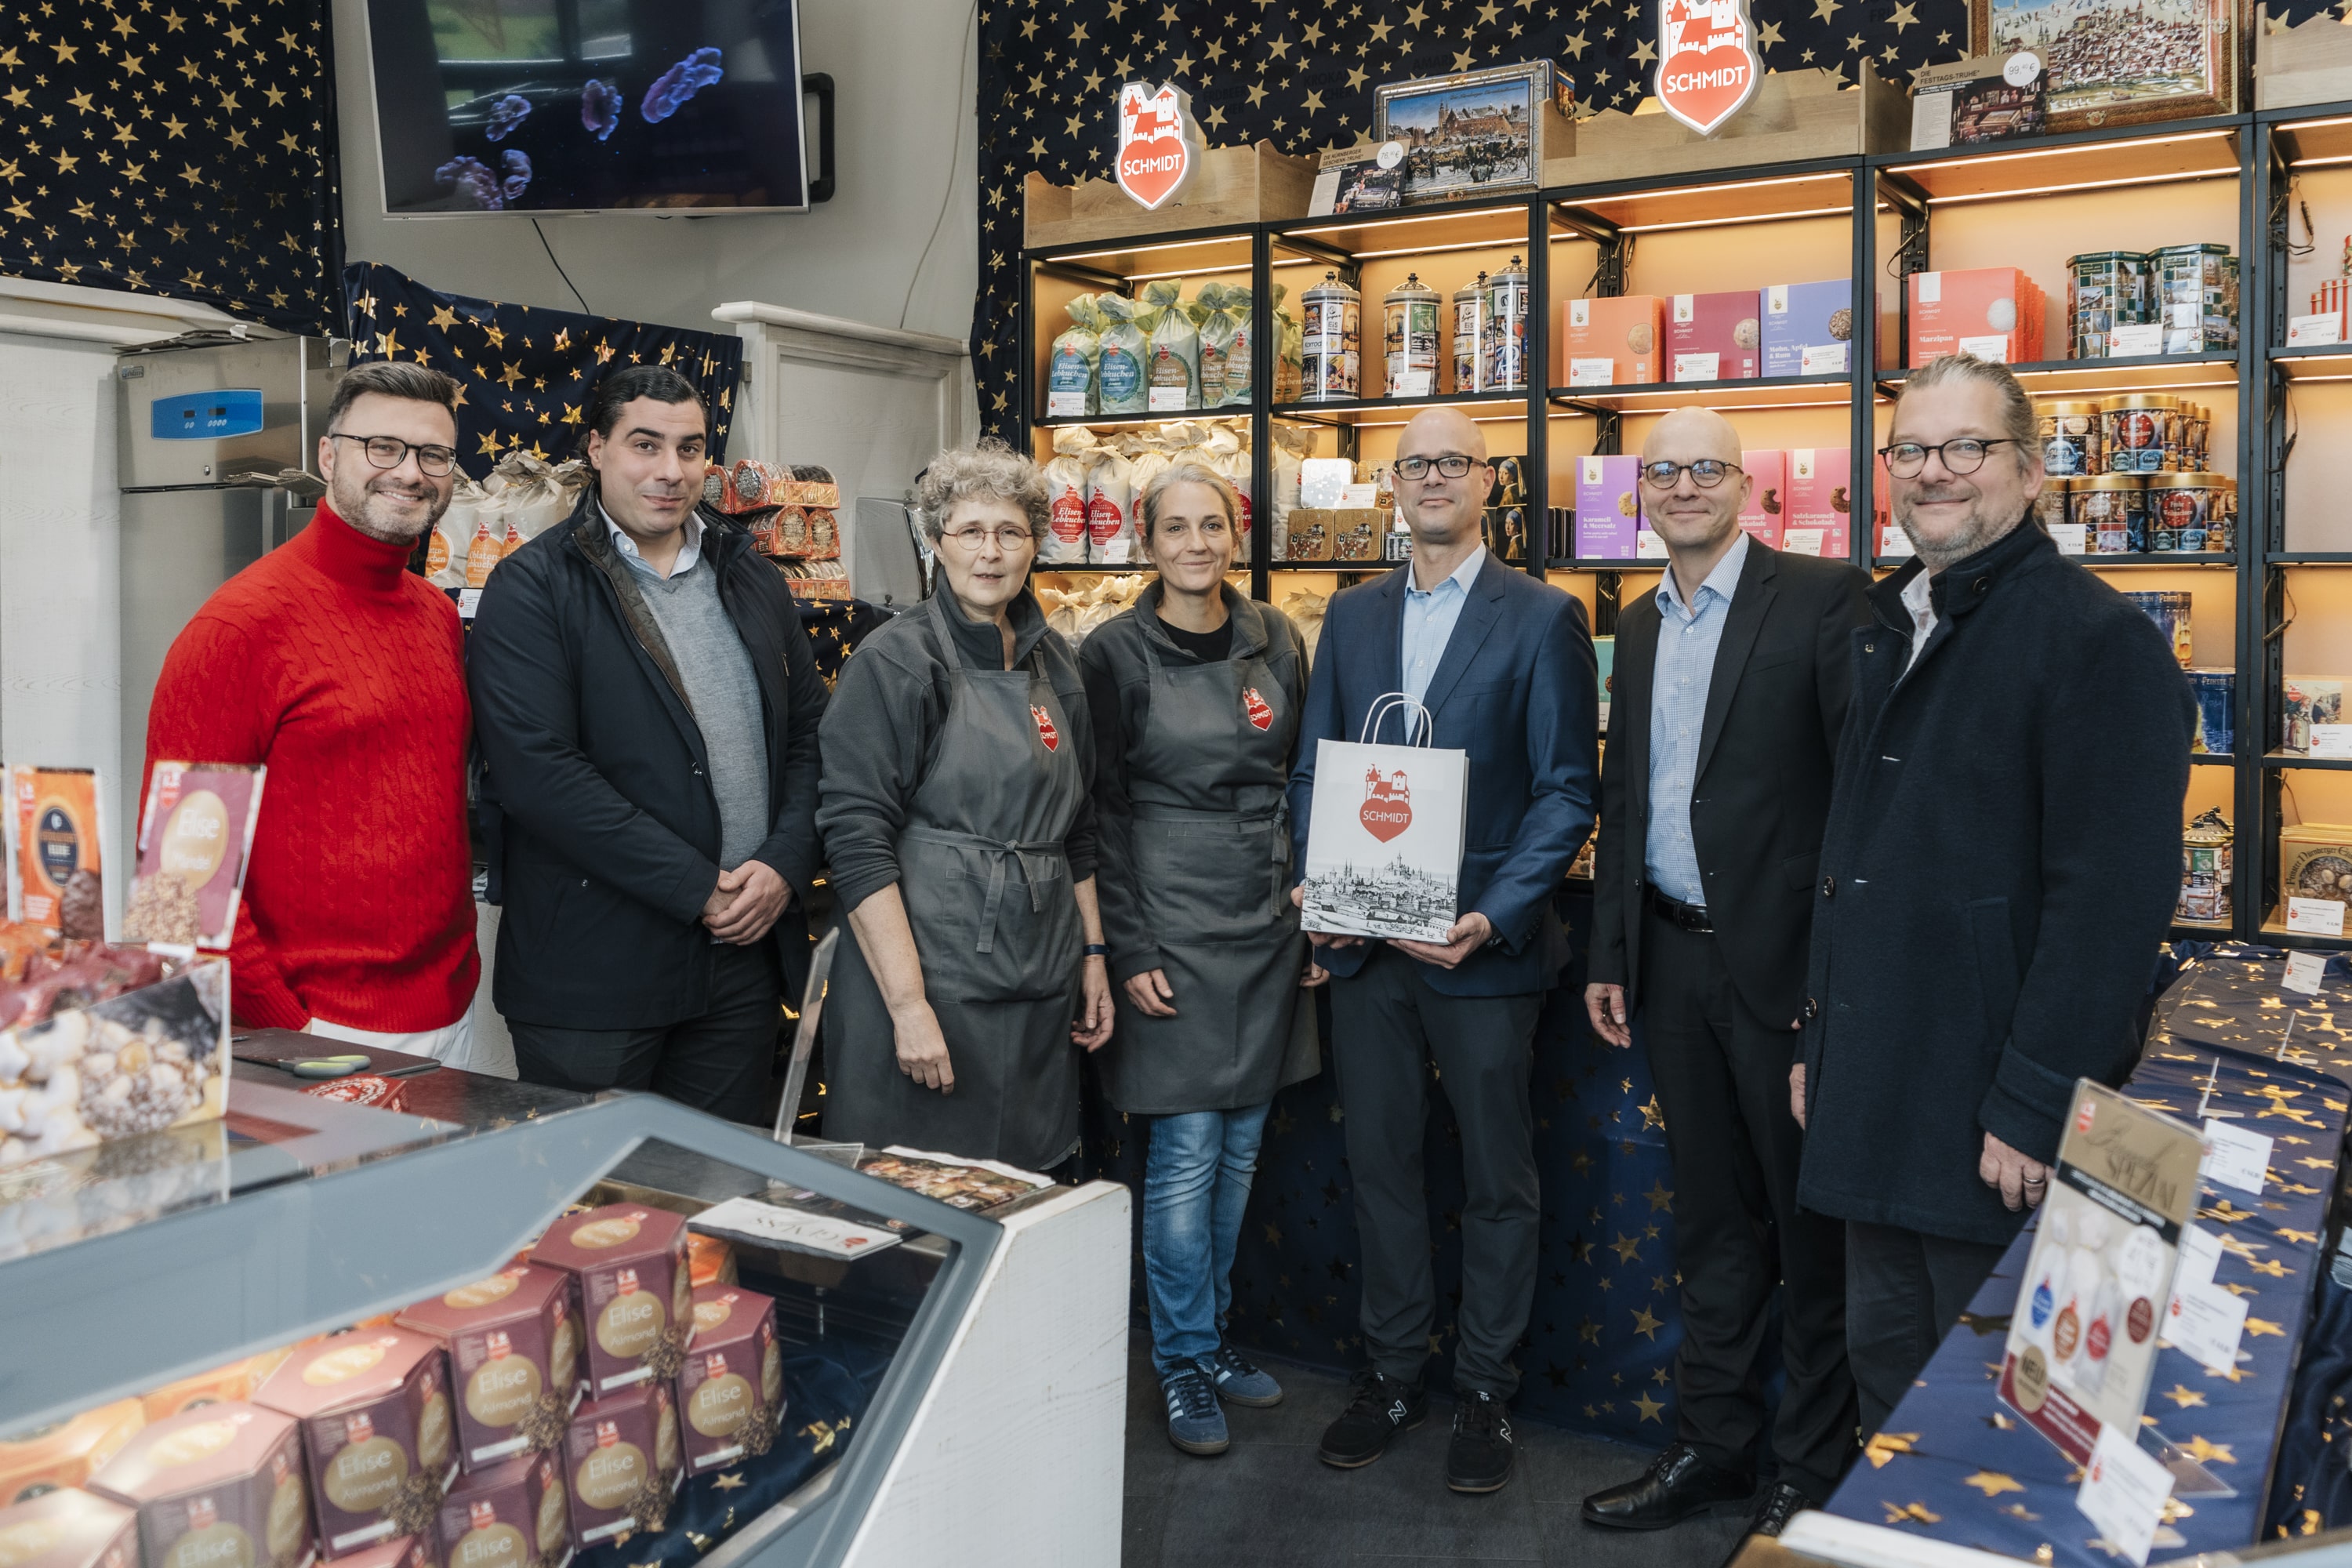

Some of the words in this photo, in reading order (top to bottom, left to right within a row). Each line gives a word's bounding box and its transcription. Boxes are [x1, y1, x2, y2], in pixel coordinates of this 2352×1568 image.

[1666, 65, 1746, 94] SCHMIDT
[1123, 154, 1181, 176] SCHMIDT
[1058, 506, 1083, 516] Elisen-
[1250, 709, 1271, 721] SCHMIDT
[177, 808, 220, 839] Elise
[1363, 810, 1410, 825] SCHMIDT
[608, 1302, 653, 1327] Elise
[611, 1326, 657, 1348] Almond
[477, 1367, 528, 1395] Elise
[482, 1392, 532, 1414] Almond
[698, 1385, 742, 1409] Elise
[702, 1406, 746, 1427] Almond
[336, 1450, 392, 1480] Elise
[589, 1454, 634, 1480] Elise
[342, 1474, 398, 1501] Almond
[590, 1476, 639, 1498] Almond
[177, 1536, 238, 1567] Elise
[462, 1536, 514, 1564] Elise
